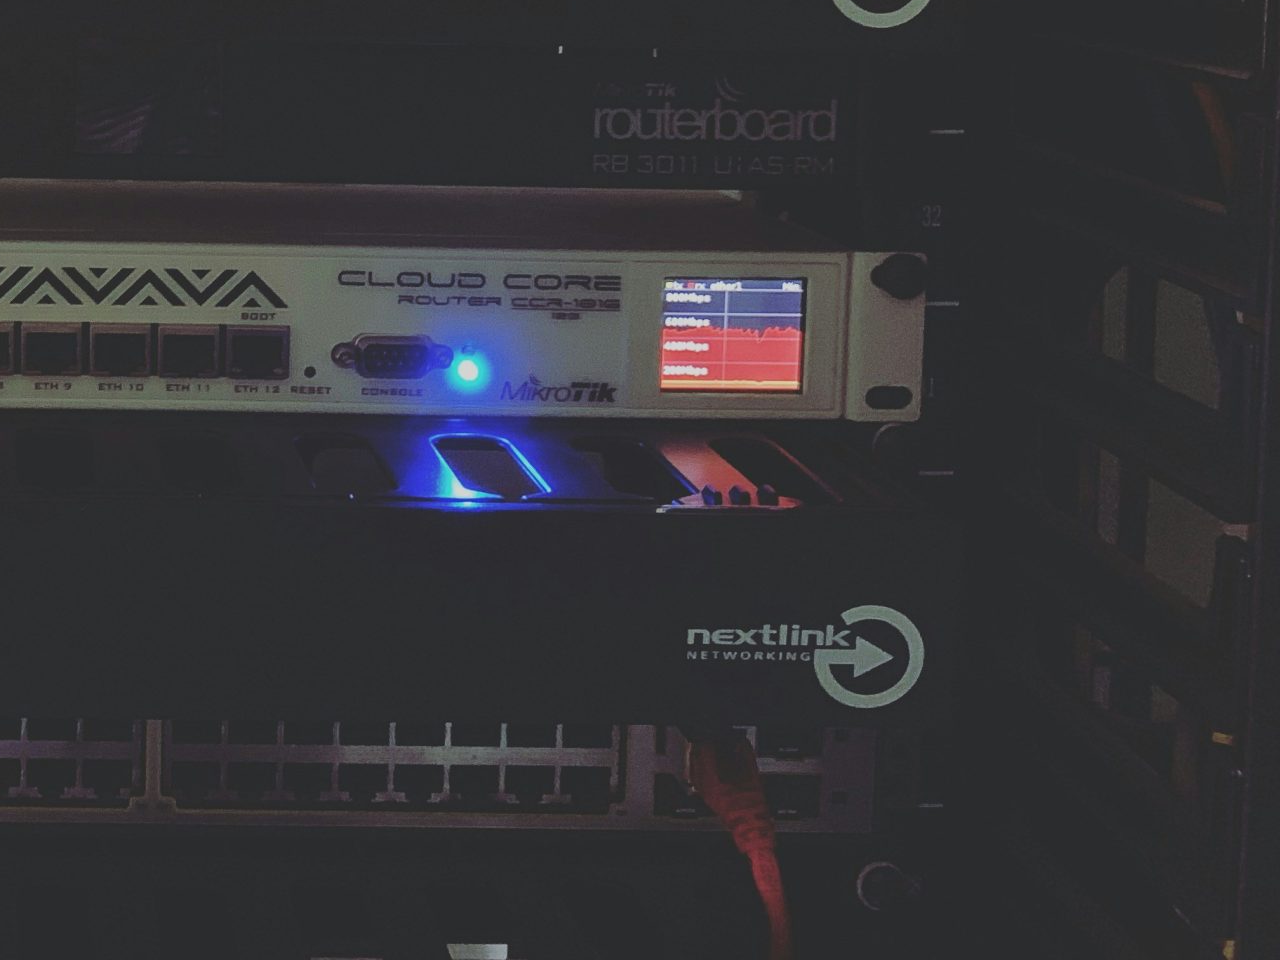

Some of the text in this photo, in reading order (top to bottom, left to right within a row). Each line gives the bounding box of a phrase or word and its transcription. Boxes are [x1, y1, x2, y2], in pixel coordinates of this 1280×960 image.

[593, 98, 839, 141] routerboard
[338, 270, 622, 290] CLOUD CORE
[398, 295, 502, 306] ROUTER
[241, 312, 277, 321] BOOT
[290, 385, 332, 395] RESET
[500, 378, 617, 403] MikroTik
[687, 624, 851, 646] nextlink
[687, 651, 811, 662] NETWORKING
